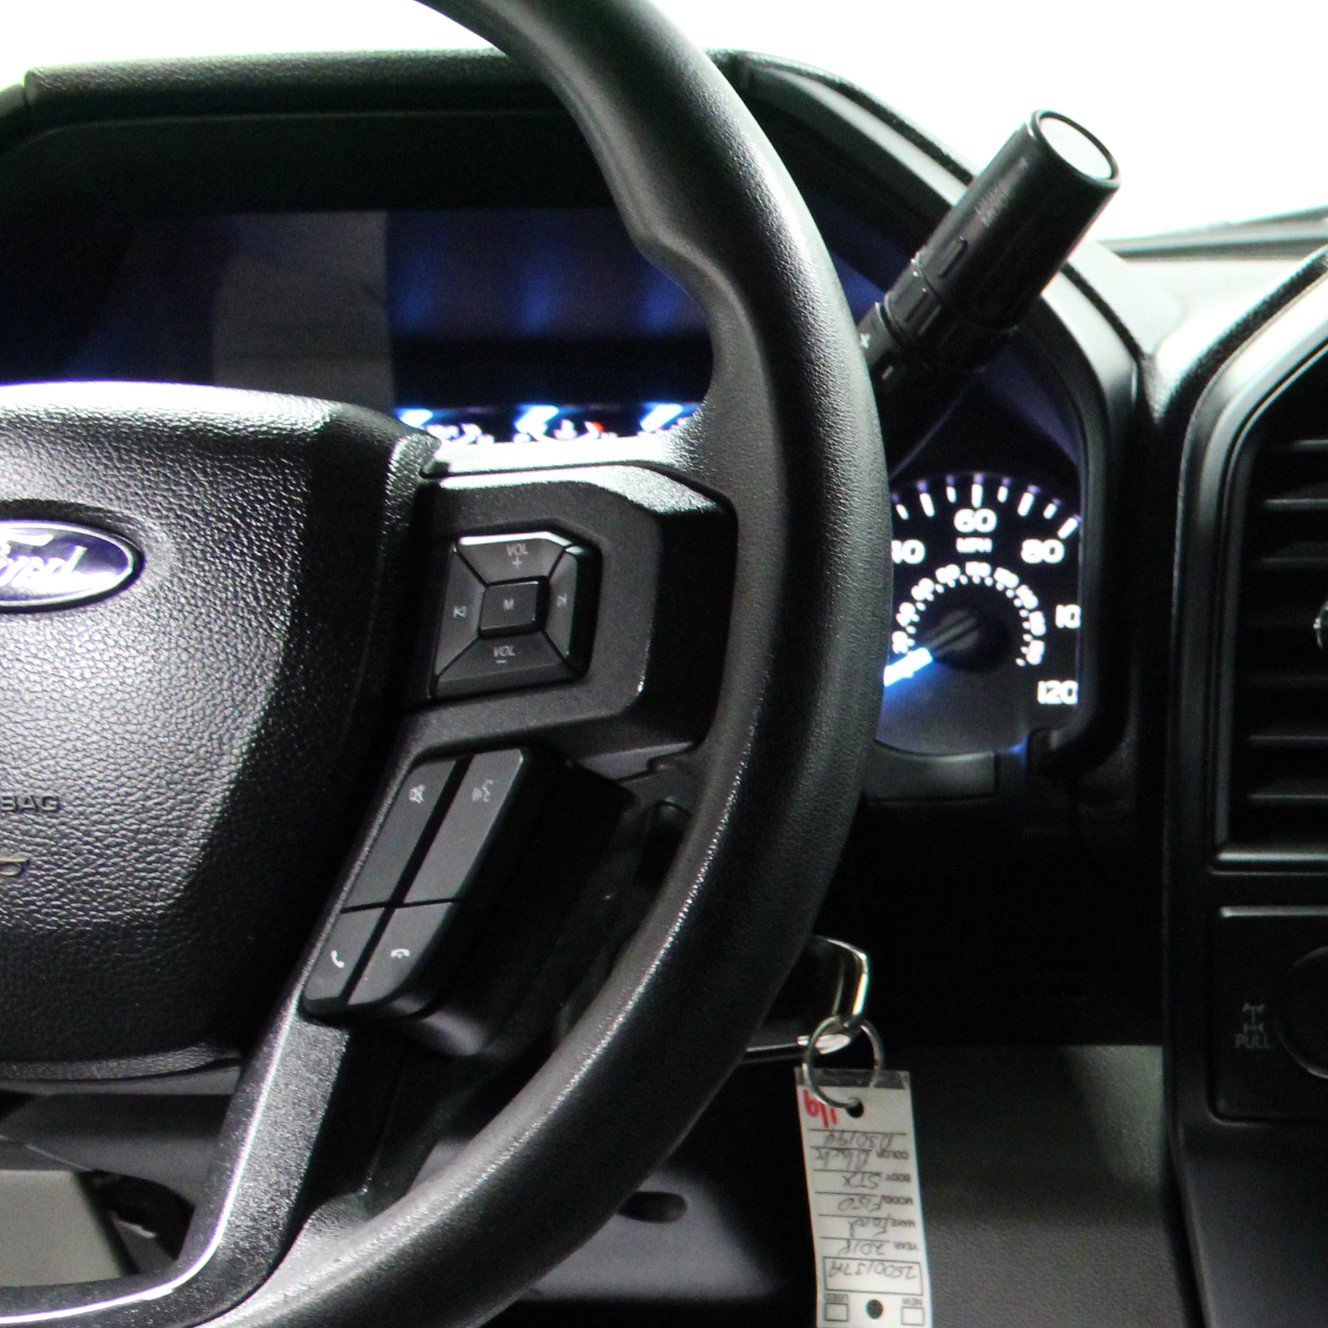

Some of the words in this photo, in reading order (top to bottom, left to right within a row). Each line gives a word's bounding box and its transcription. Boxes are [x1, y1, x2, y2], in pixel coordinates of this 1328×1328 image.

[954, 508, 997, 533] 60
[506, 542, 529, 557] VOL
[1021, 538, 1065, 564] 80
[493, 644, 516, 658] VOL
[1037, 680, 1079, 705] 120
